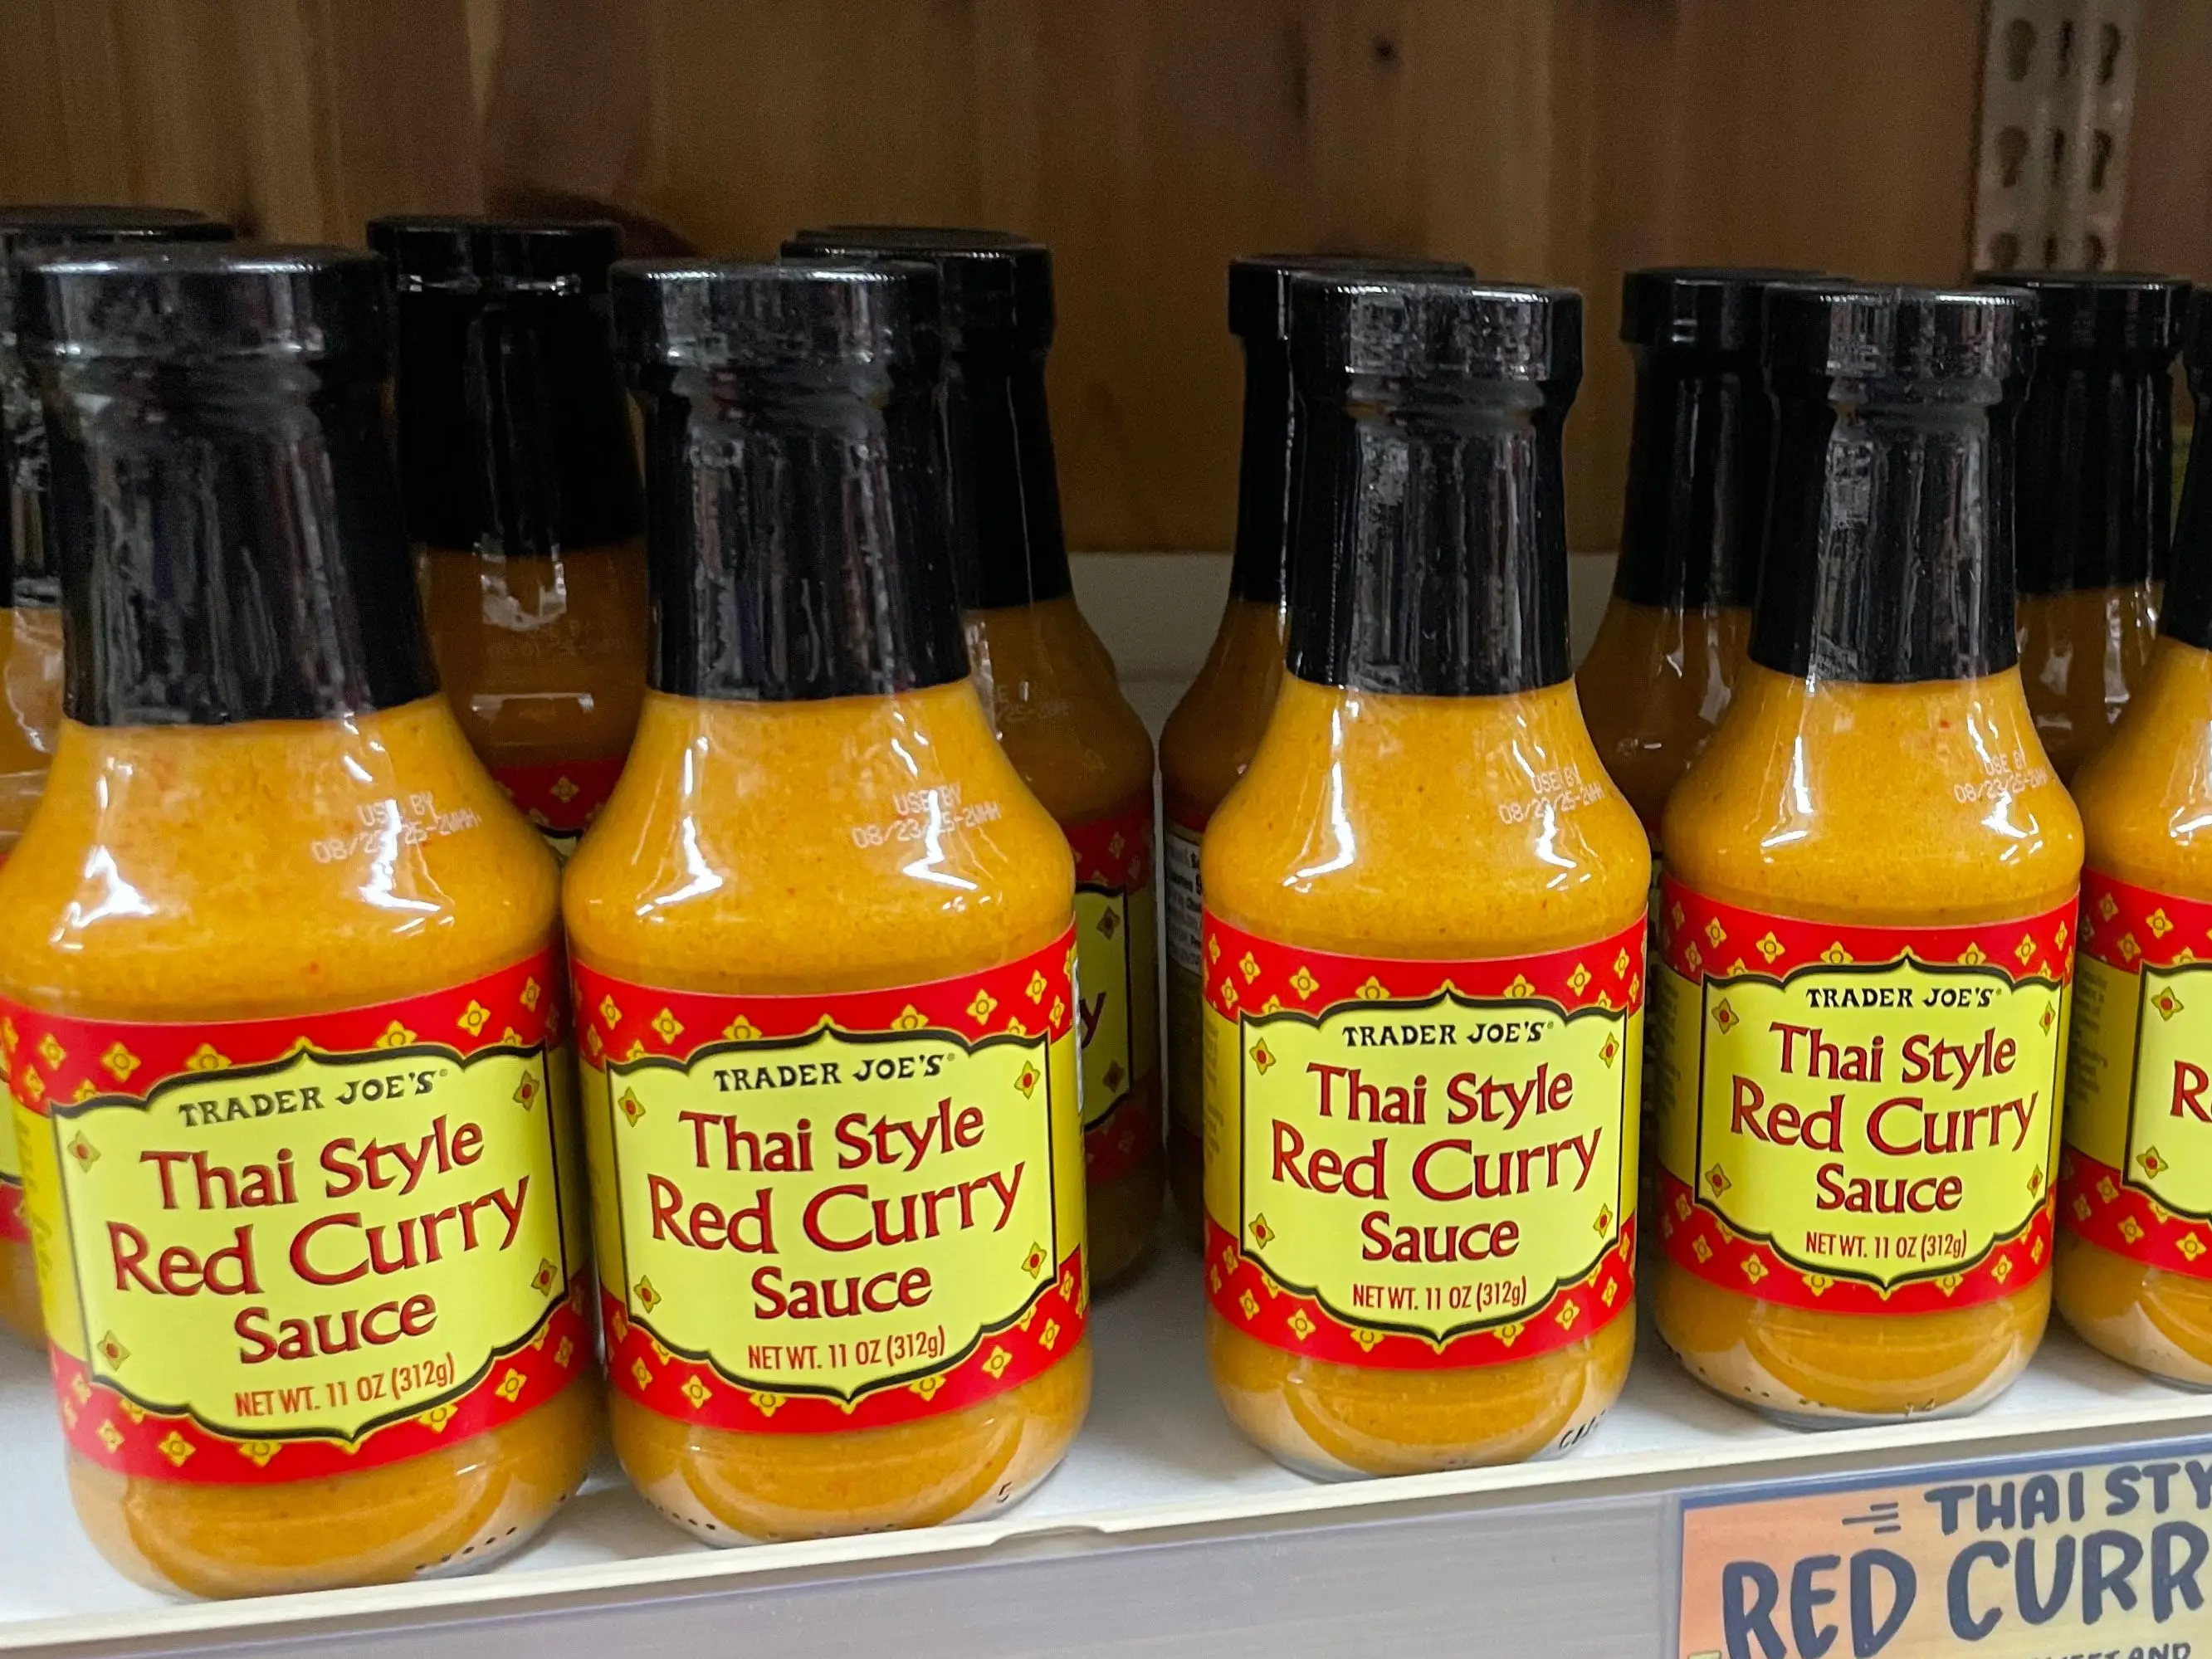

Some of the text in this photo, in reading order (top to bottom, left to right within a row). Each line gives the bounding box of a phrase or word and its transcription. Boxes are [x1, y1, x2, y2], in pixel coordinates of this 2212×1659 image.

[1531, 769, 1564, 794] USE
[1984, 753, 2011, 776] USE
[357, 799, 398, 827] US
[892, 788, 930, 817] USE
[1805, 988, 1913, 1008] TRADER
[1342, 1024, 1457, 1047] TRADER
[1768, 1021, 1884, 1083] Thai
[1902, 1027, 2016, 1091] Style
[714, 1062, 842, 1092] TRADER
[1306, 1061, 1574, 1130] Thai Style
[178, 1086, 325, 1127] TRADER
[1730, 1073, 2039, 1156] Red Curry
[678, 1096, 984, 1173] Thai Style
[1272, 1118, 1603, 1203] Red Curry
[139, 1148, 297, 1210] Thai
[320, 1114, 484, 1198] Style
[1816, 1162, 1963, 1214] Sauce
[647, 1161, 1025, 1255] Red Curry
[106, 1174, 530, 1297] Red Curry
[1360, 1210, 1520, 1263] Sauce
[1805, 1229, 1967, 1263] NET WT. 11 OZ (312g)
[750, 1266, 933, 1320] Sauce
[1353, 1275, 1527, 1313] NET WT. 11 OZ (312g)
[233, 1294, 437, 1364] Sauce
[747, 1325, 945, 1370] NET WT. 11 OZ (312g)
[234, 1351, 455, 1417] NET WT. 11 OZ (312g)
[1924, 1471, 2085, 1536] THAI
[1722, 1520, 2210, 1659] RED CURR
